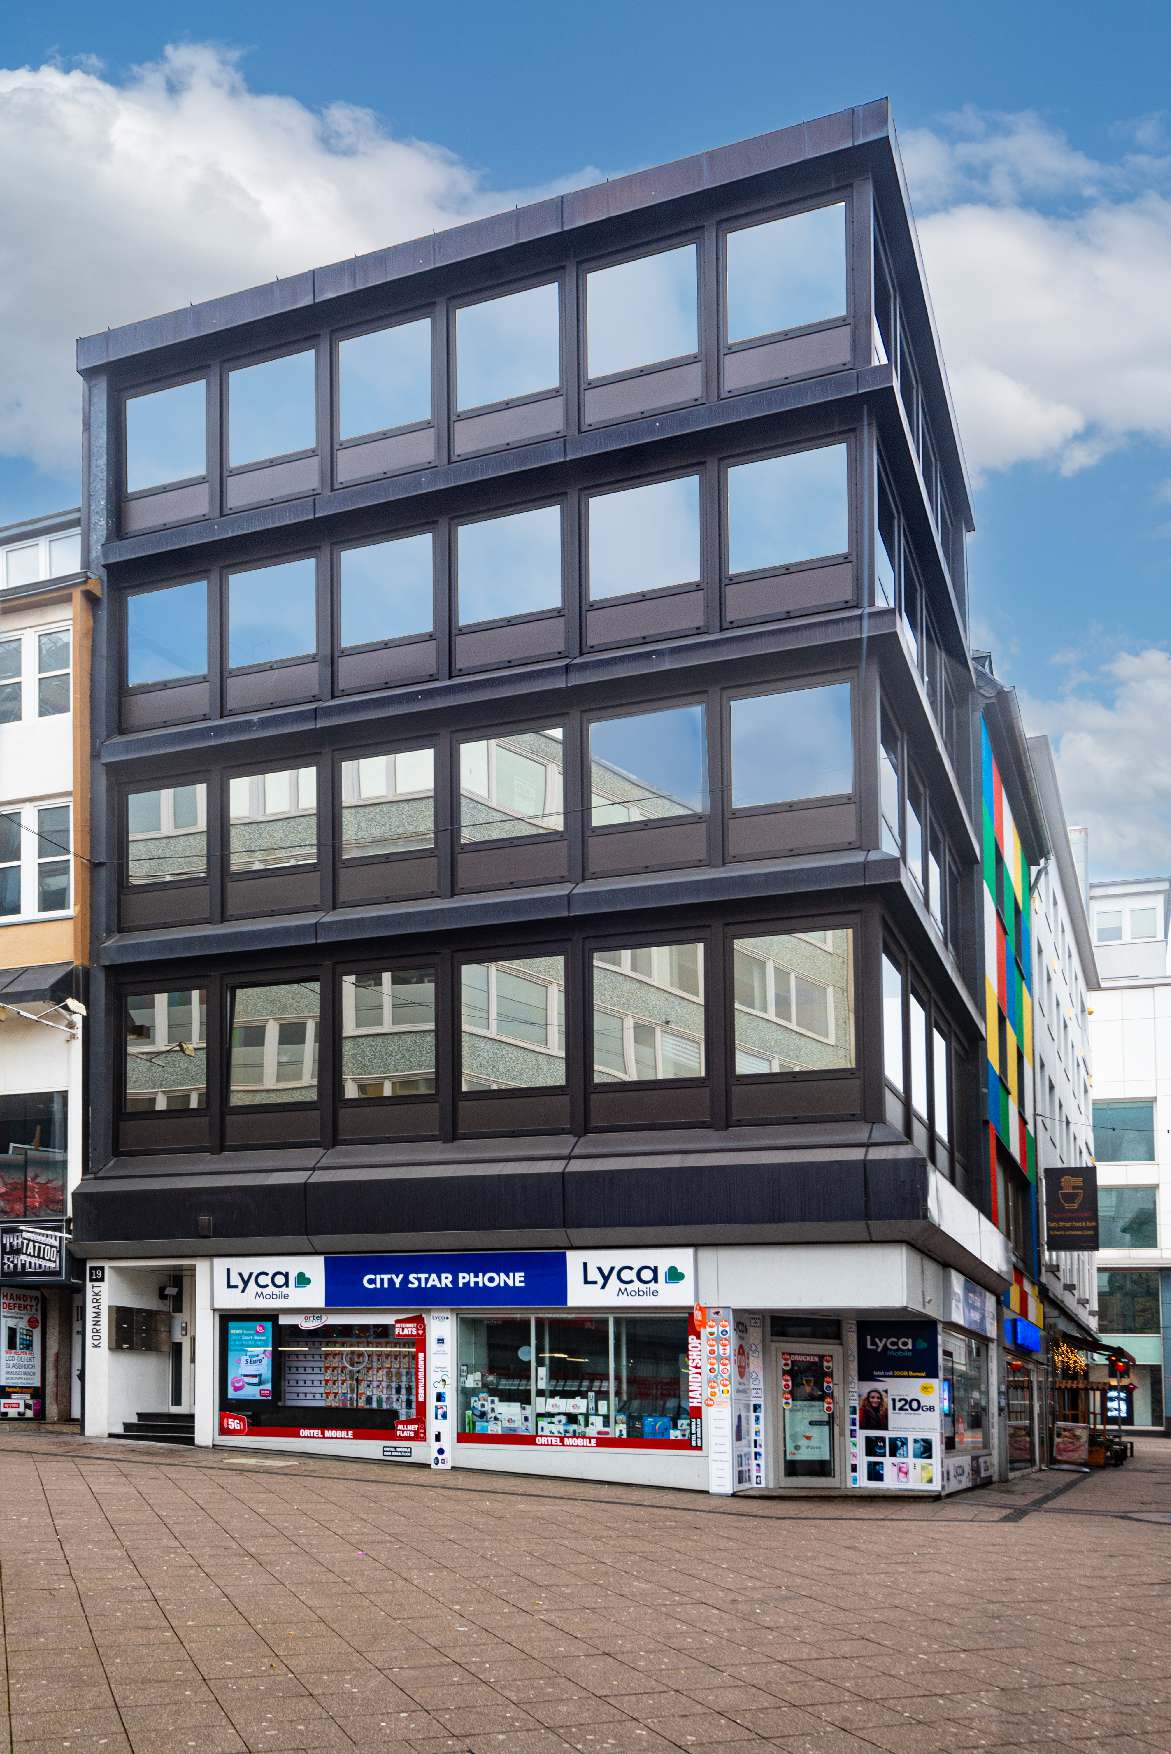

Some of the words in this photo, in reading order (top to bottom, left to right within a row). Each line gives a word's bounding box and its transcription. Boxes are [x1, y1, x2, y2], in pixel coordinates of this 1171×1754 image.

[22, 1239, 57, 1261] TATTOO
[91, 1269, 102, 1279] 19
[583, 1262, 659, 1289] Lyca
[226, 1268, 289, 1293] Lyca
[363, 1274, 403, 1289] CITY
[408, 1273, 453, 1288] STAR
[458, 1272, 525, 1288] PHONE
[2, 1291, 34, 1303] HANDY
[254, 1291, 289, 1300] Mobile
[616, 1287, 659, 1297] Mobile
[91, 1283, 102, 1349] KORNMARKT
[395, 1327, 417, 1335] FLATS
[866, 1336, 912, 1352] Lyca
[790, 1354, 819, 1362] DRUCKEN
[688, 1335, 702, 1407] HANDYSHOP
[228, 1418, 240, 1430] 5G
[299, 1428, 323, 1438] ORTEL
[324, 1429, 353, 1439] MOBILE
[535, 1436, 562, 1446] ORTEL
[563, 1436, 597, 1447] MOBILE
